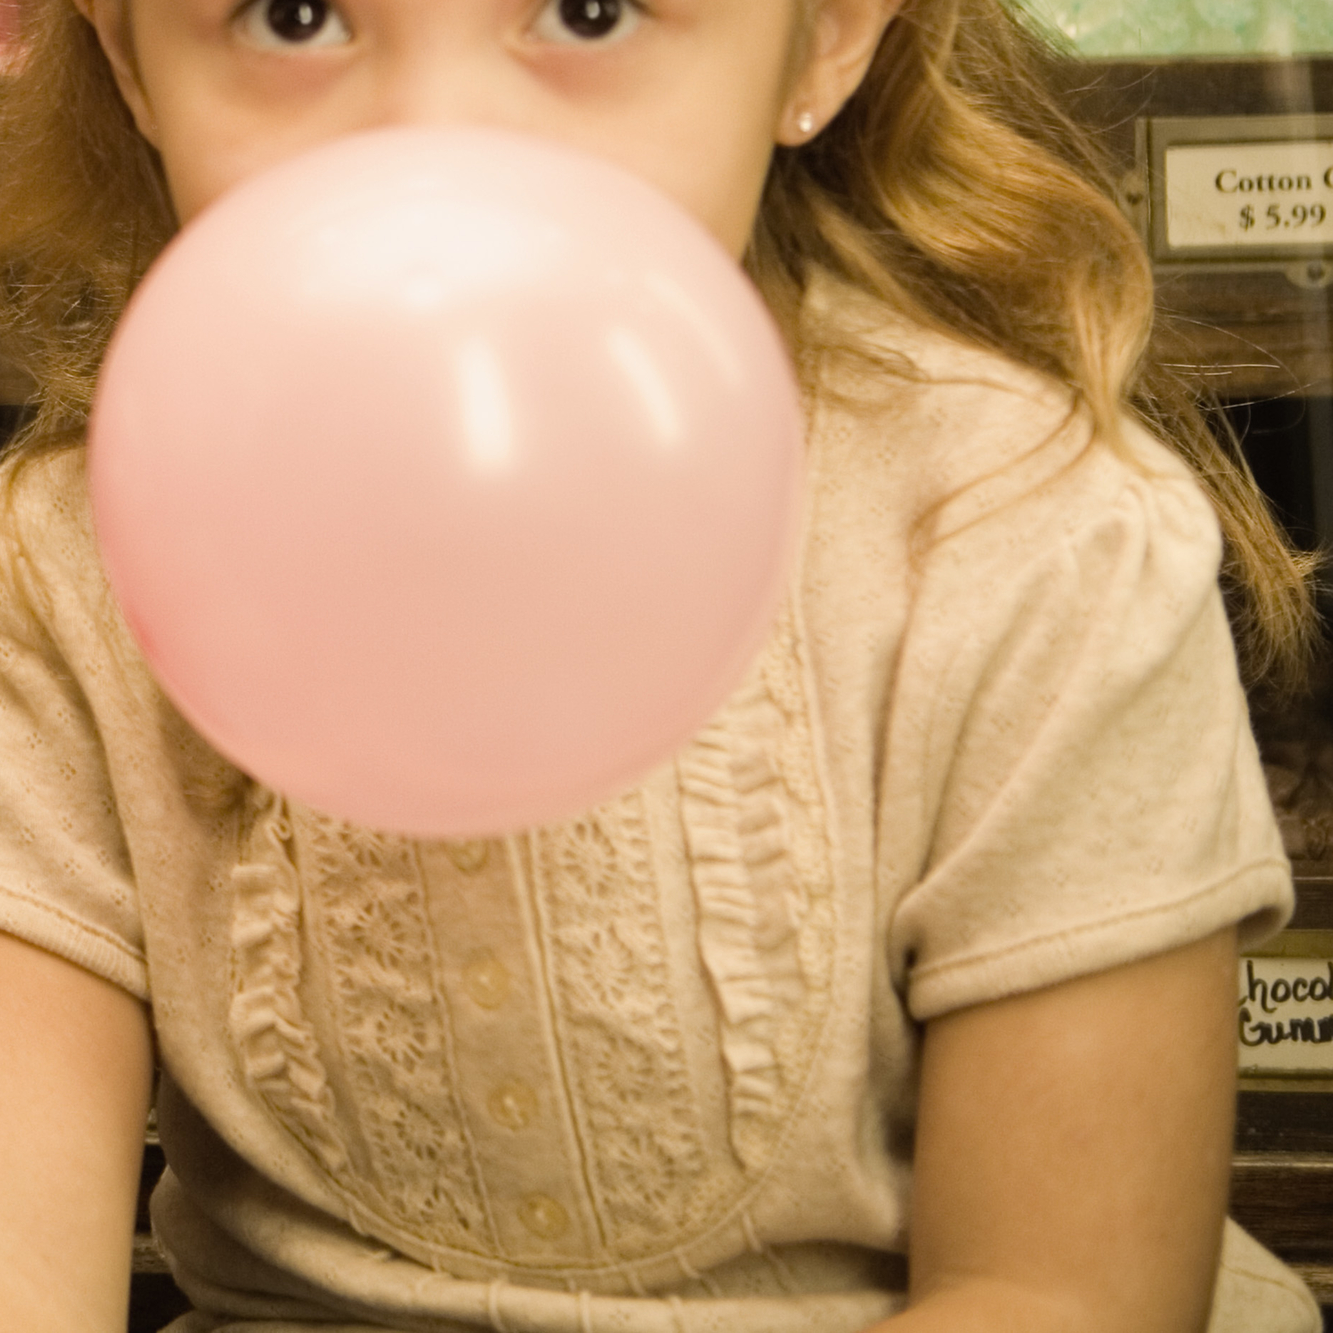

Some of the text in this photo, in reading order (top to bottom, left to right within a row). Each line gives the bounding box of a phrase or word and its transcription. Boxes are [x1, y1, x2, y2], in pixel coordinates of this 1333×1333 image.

[1215, 169, 1312, 193] Cotton
[1239, 203, 1327, 233] $ 5.99
